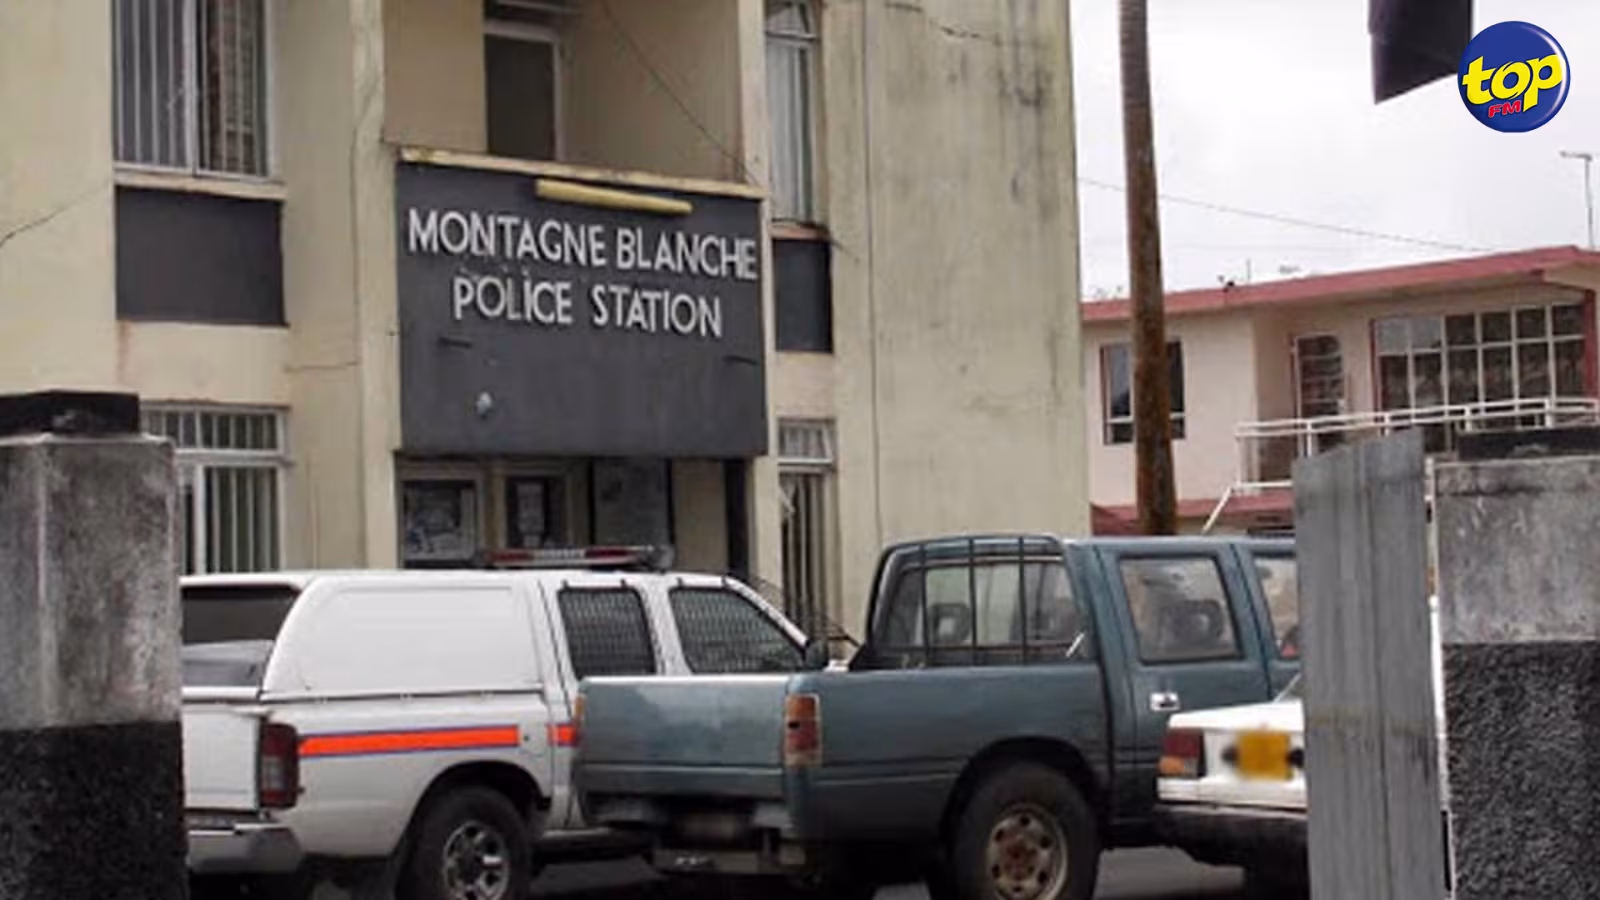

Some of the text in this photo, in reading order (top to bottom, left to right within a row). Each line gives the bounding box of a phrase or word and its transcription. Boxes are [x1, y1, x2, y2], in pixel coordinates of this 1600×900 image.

[408, 207, 759, 281] MONTAGNE BLANCHE
[453, 274, 723, 337] POLICE STATION
